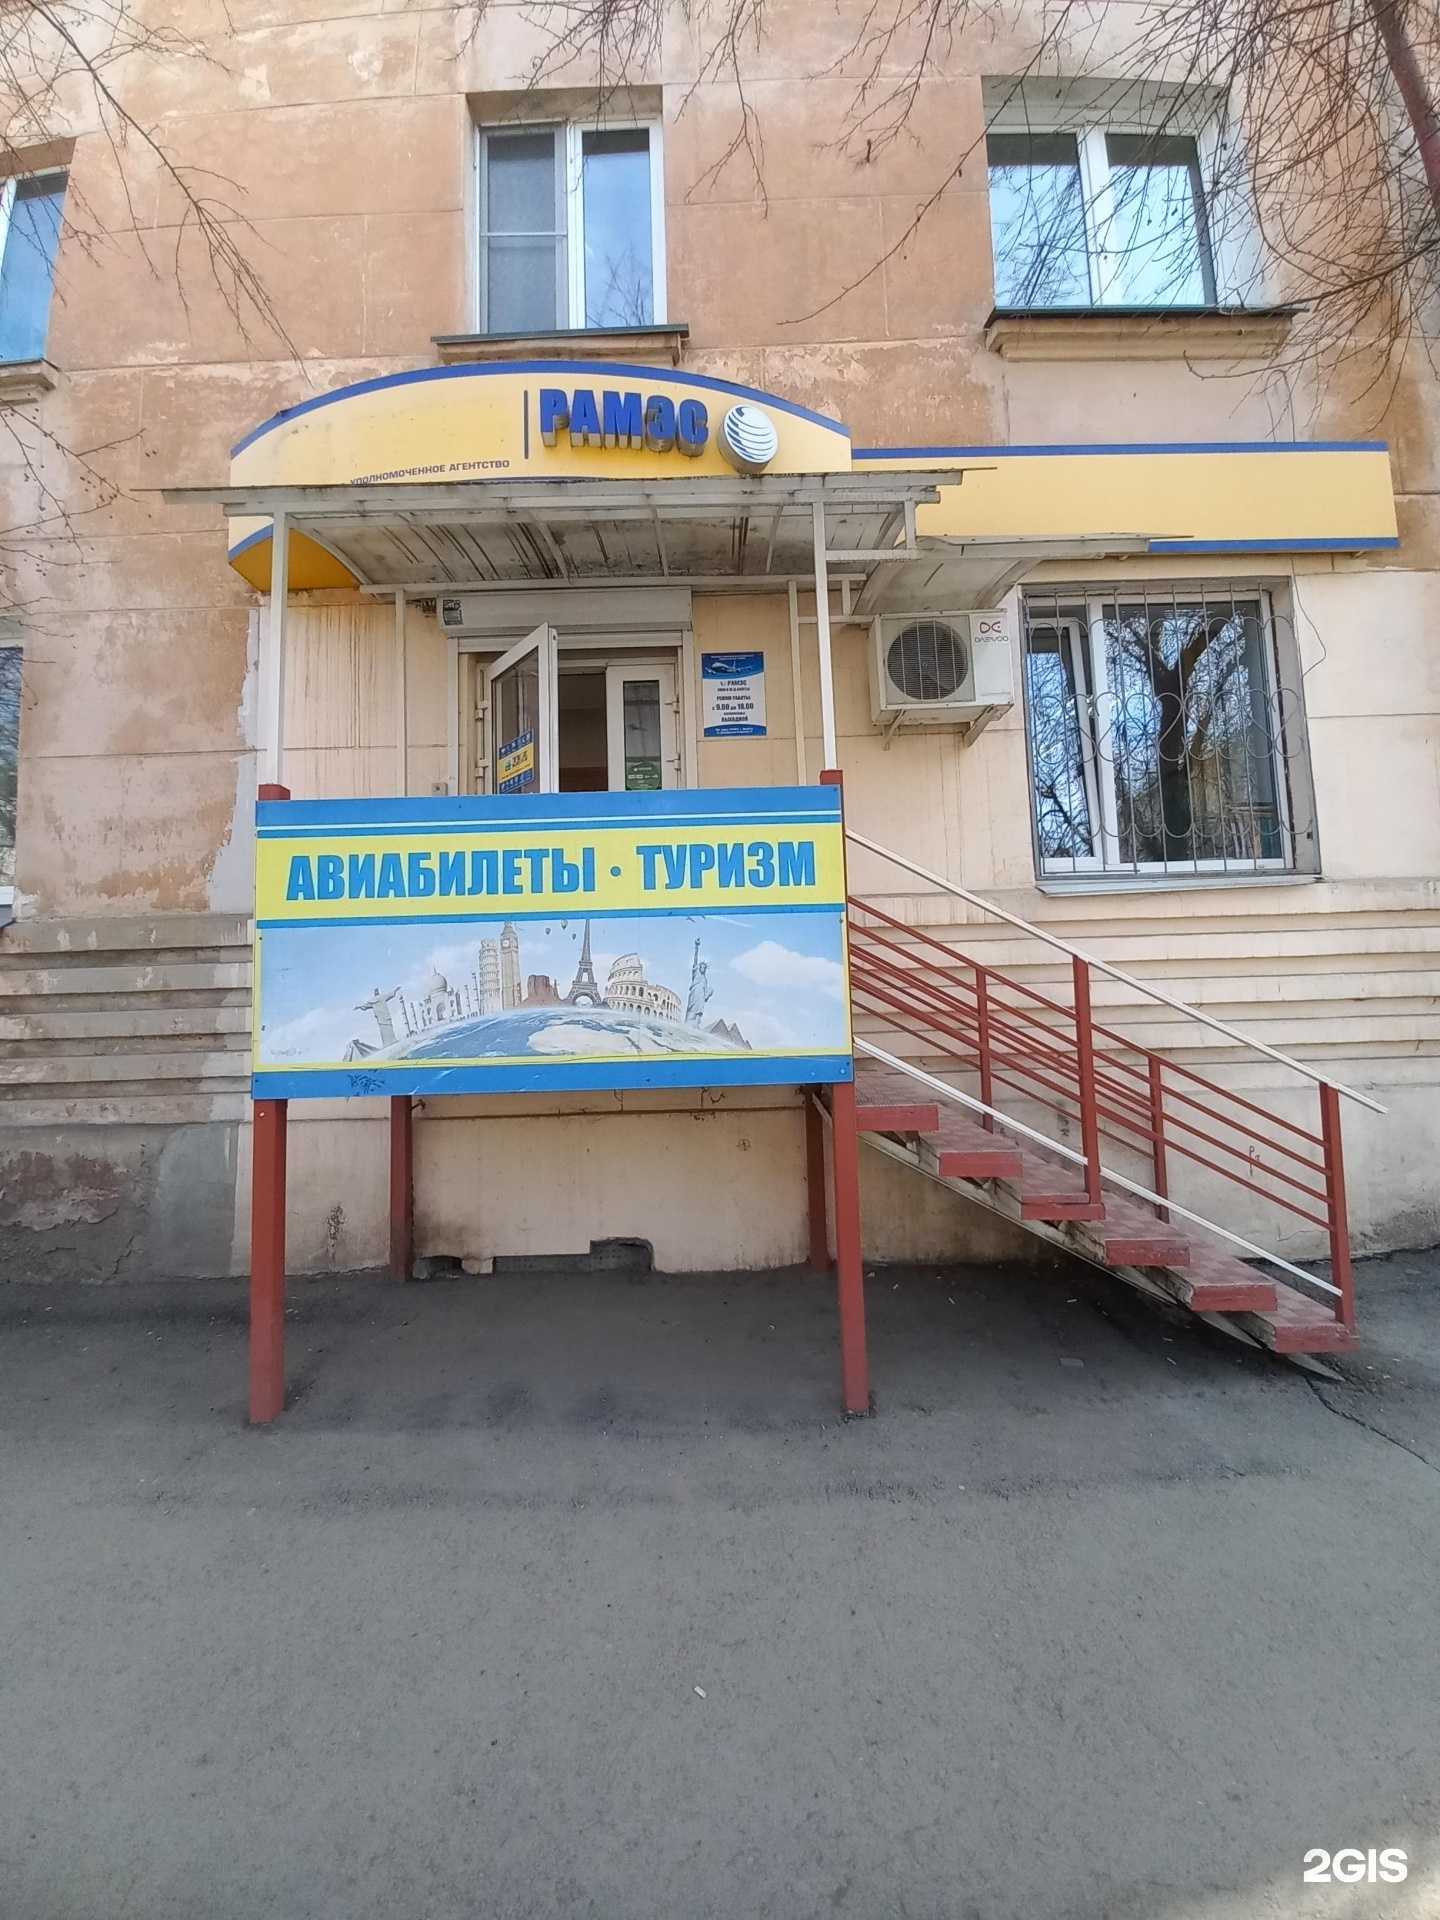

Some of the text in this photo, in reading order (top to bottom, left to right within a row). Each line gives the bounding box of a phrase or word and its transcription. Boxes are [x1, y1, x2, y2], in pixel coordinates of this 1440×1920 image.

[539, 388, 709, 456] РАМЭС
[449, 460, 510, 472] АГЕНТСТВО
[286, 840, 817, 901] АВИАБИЛЕТЫ ТУРИЗМ
